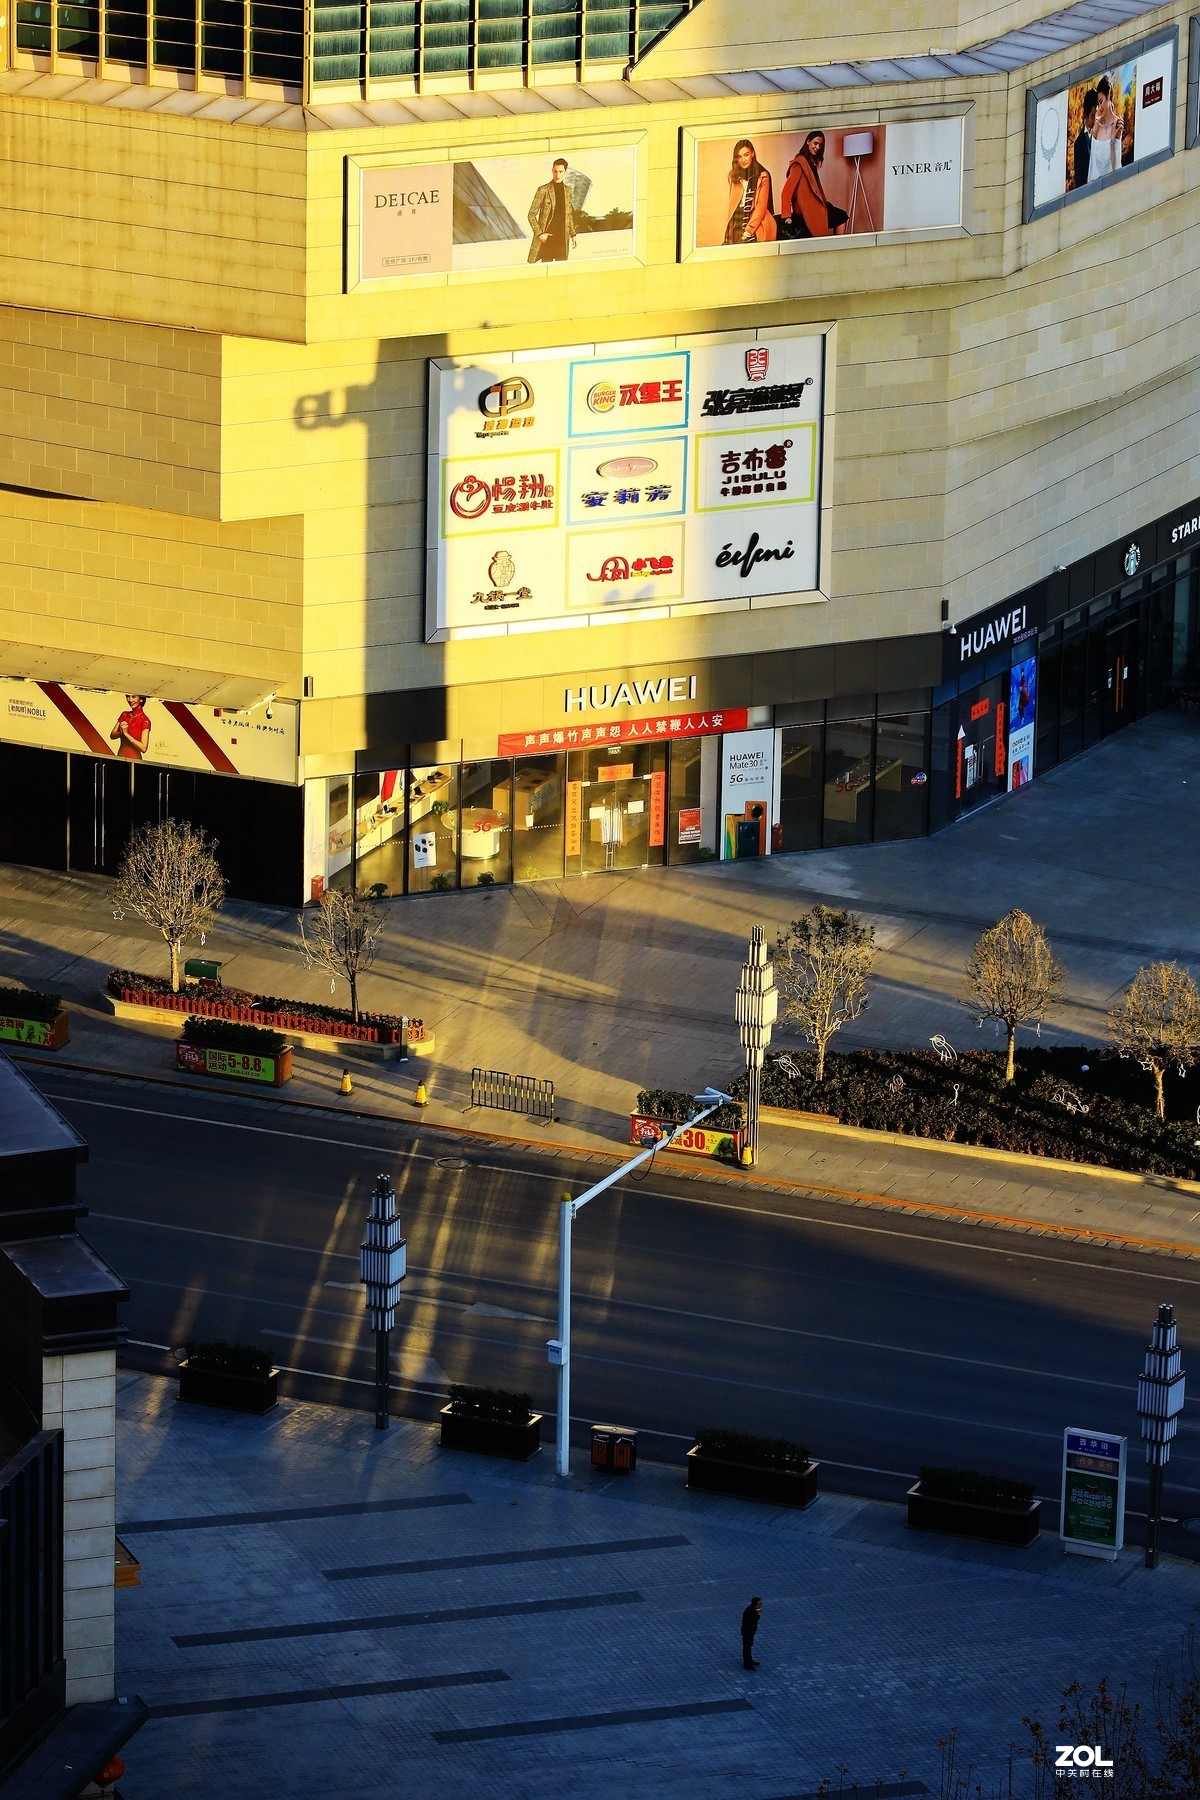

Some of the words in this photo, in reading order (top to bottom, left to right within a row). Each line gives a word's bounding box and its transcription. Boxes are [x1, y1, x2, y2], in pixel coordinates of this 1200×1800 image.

[891, 162, 932, 176] YINER
[374, 190, 440, 208] DEICAE
[593, 389, 617, 399] BURGER
[619, 380, 683, 407] 汉堡王
[593, 396, 616, 406] KING
[720, 444, 787, 474] 吉布鲁
[631, 463, 653, 472] Form
[722, 470, 786, 485] JIBULU
[581, 484, 672, 508] 安莉芳
[1171, 515, 1200, 543] STAR
[960, 605, 1026, 661] HUAWEI
[564, 675, 697, 713] HUAWEI
[27, 707, 46, 717] NOBLE
[524, 726, 621, 747] 声声爆竹声声怨
[627, 714, 723, 735] 人人禁鞭人人安
[729, 752, 764, 762] HUAWEI
[729, 759, 758, 770] Mate30
[729, 774, 744, 784] 5G
[836, 782, 853, 793] 5G
[473, 820, 492, 833] 5G
